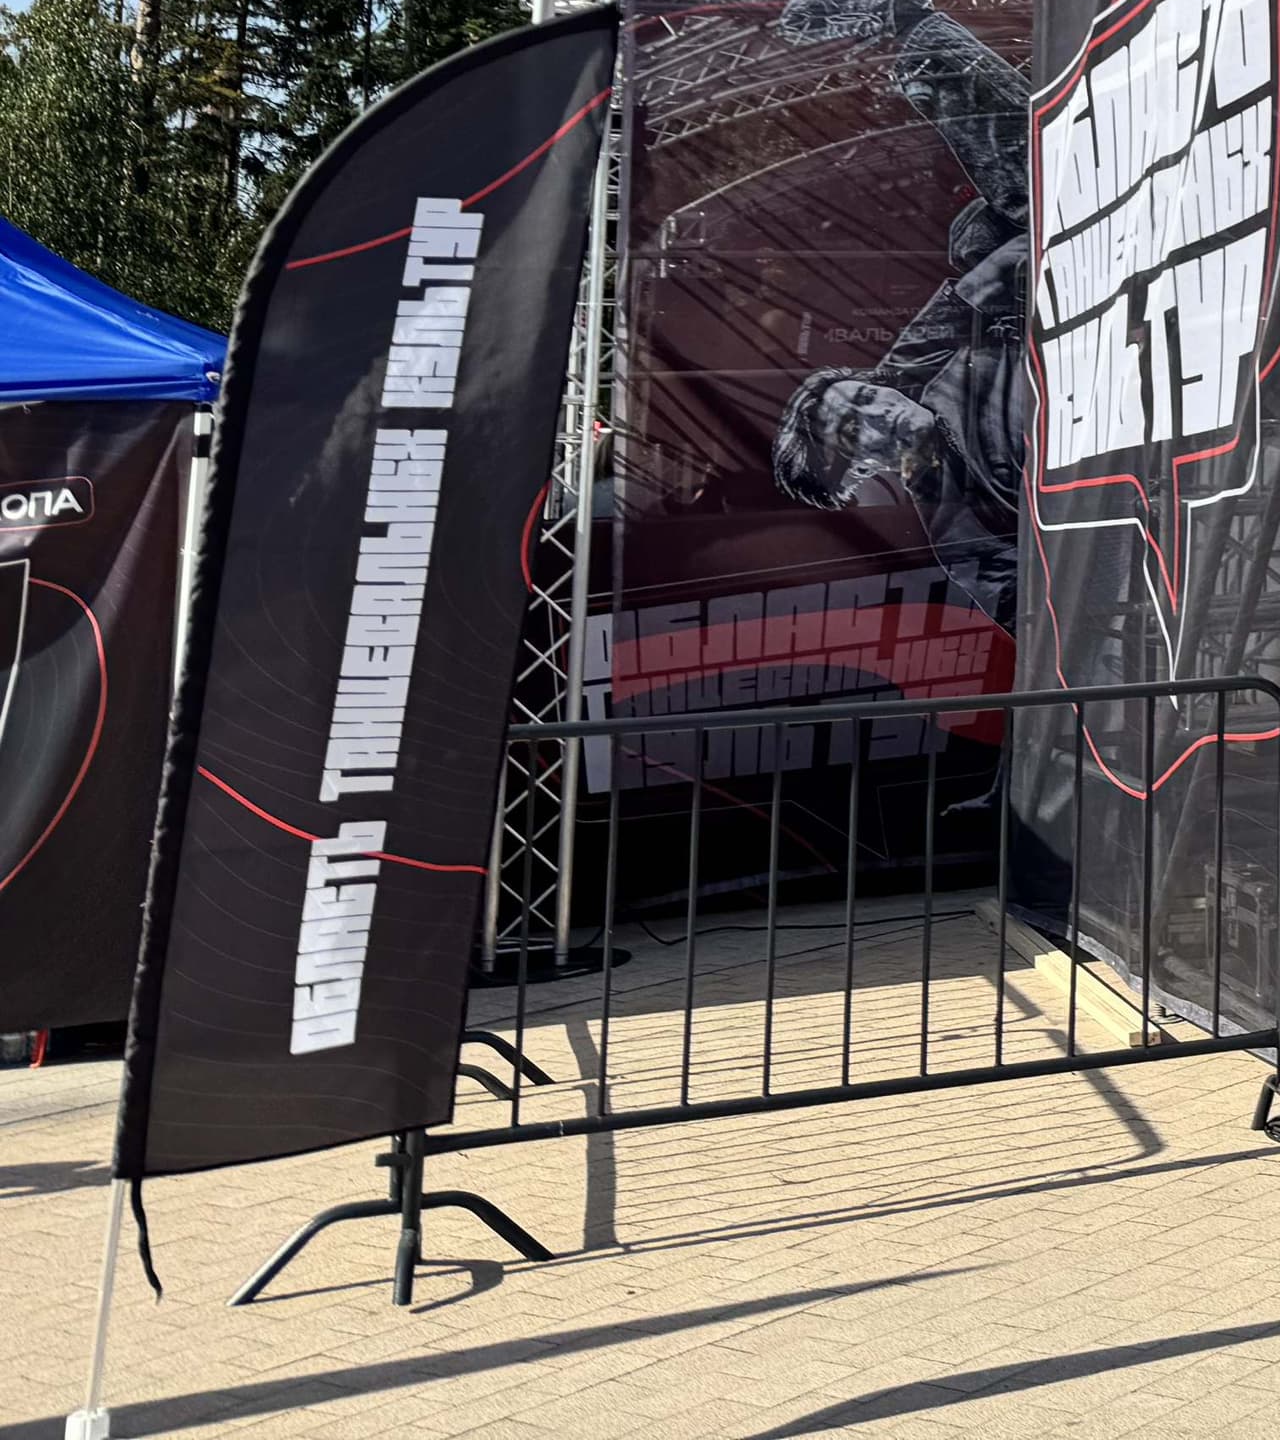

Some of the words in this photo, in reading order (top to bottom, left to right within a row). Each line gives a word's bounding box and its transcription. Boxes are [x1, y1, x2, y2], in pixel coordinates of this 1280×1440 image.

[380, 196, 485, 409] КУЛЬТУР
[0, 487, 84, 521] ОПА
[319, 428, 449, 803] ТАНЦЕВАЛЬНЫХ
[290, 820, 388, 1056] ОБЛАСТЬ
